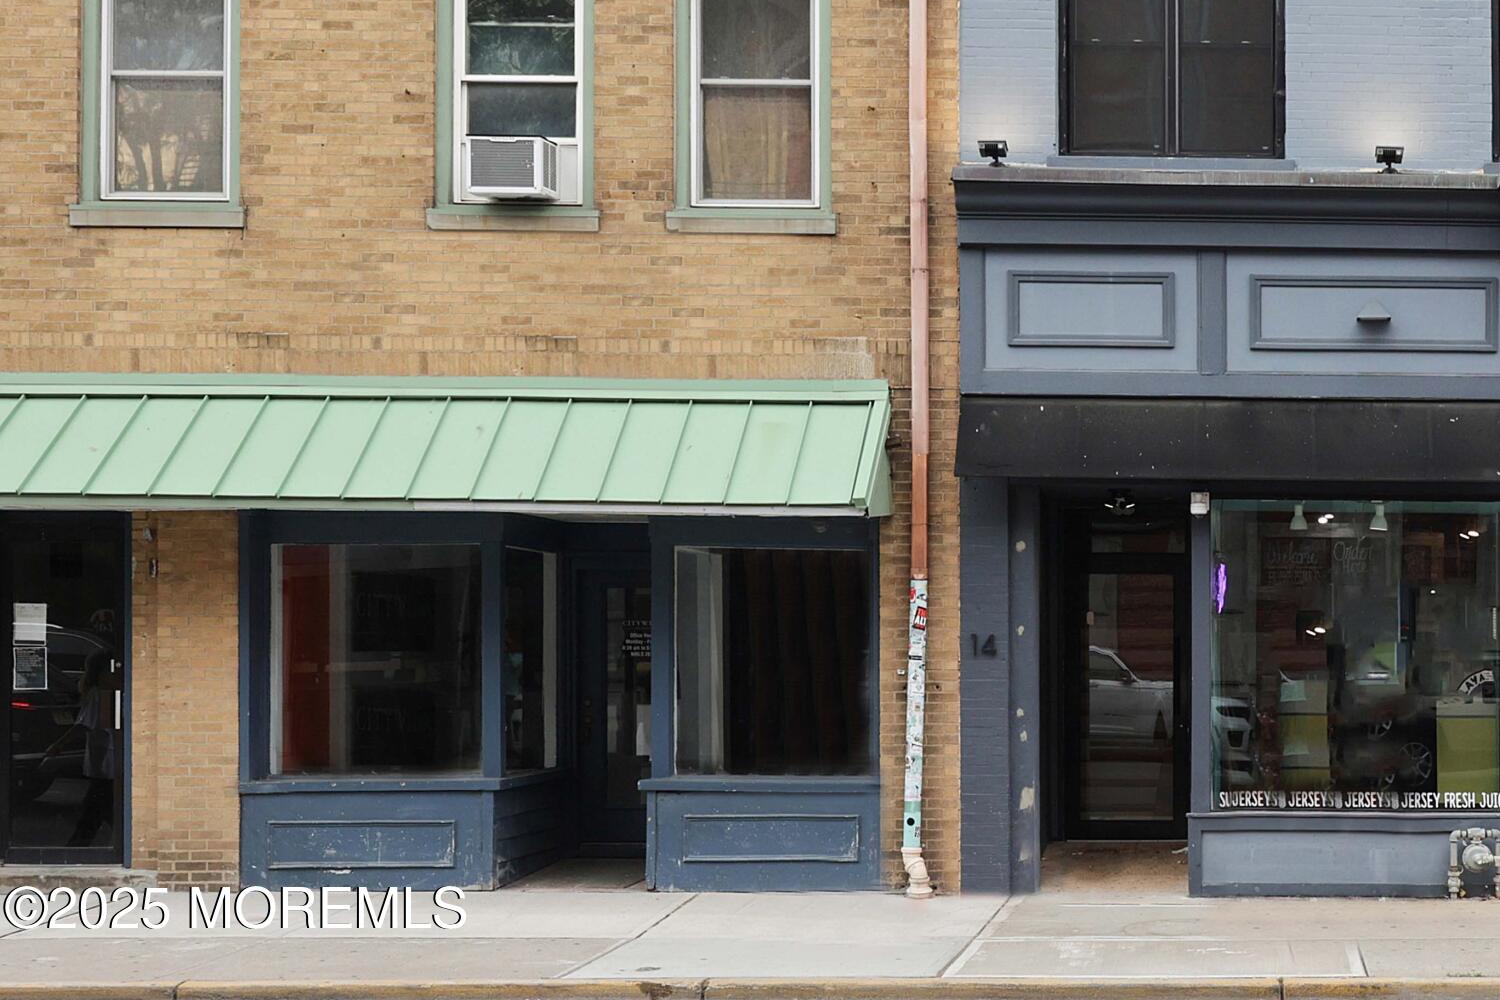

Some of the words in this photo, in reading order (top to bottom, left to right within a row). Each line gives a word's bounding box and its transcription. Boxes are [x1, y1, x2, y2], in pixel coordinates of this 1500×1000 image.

[971, 634, 997, 656] 14
[1401, 791, 1441, 808] JERSEY
[1444, 791, 1475, 808] FRESH
